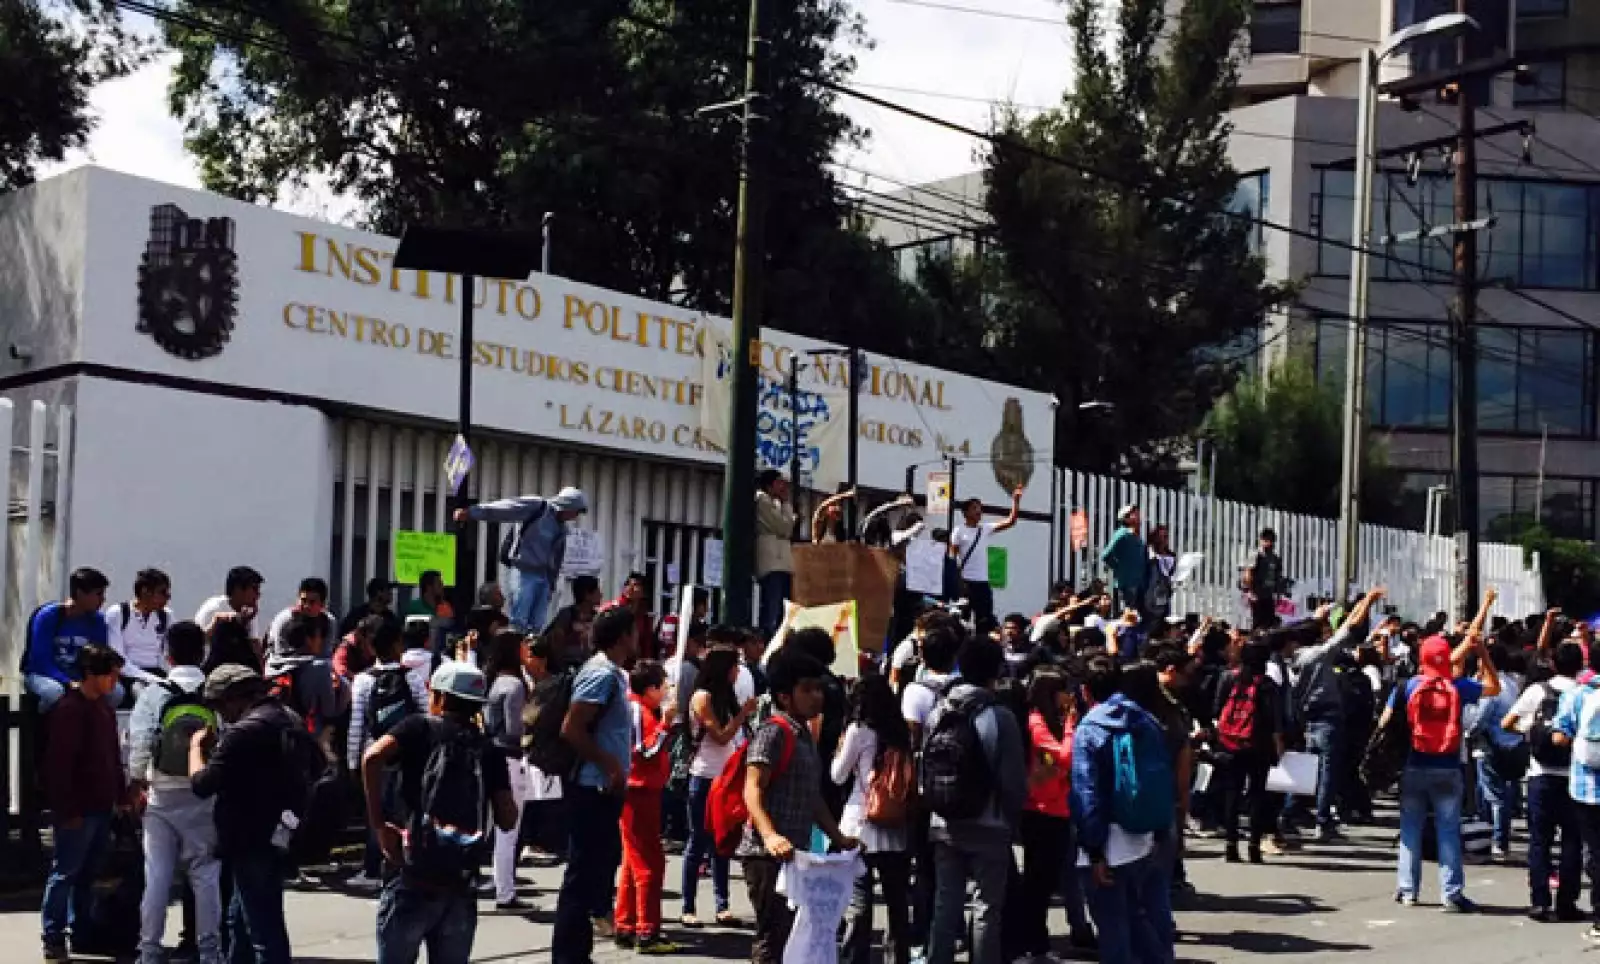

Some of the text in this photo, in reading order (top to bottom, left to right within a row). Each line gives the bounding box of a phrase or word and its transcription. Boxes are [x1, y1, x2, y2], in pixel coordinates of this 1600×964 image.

[283, 300, 411, 348] CENTRO
[417, 327, 454, 360] DE
[595, 365, 704, 405] CIENTÍF
